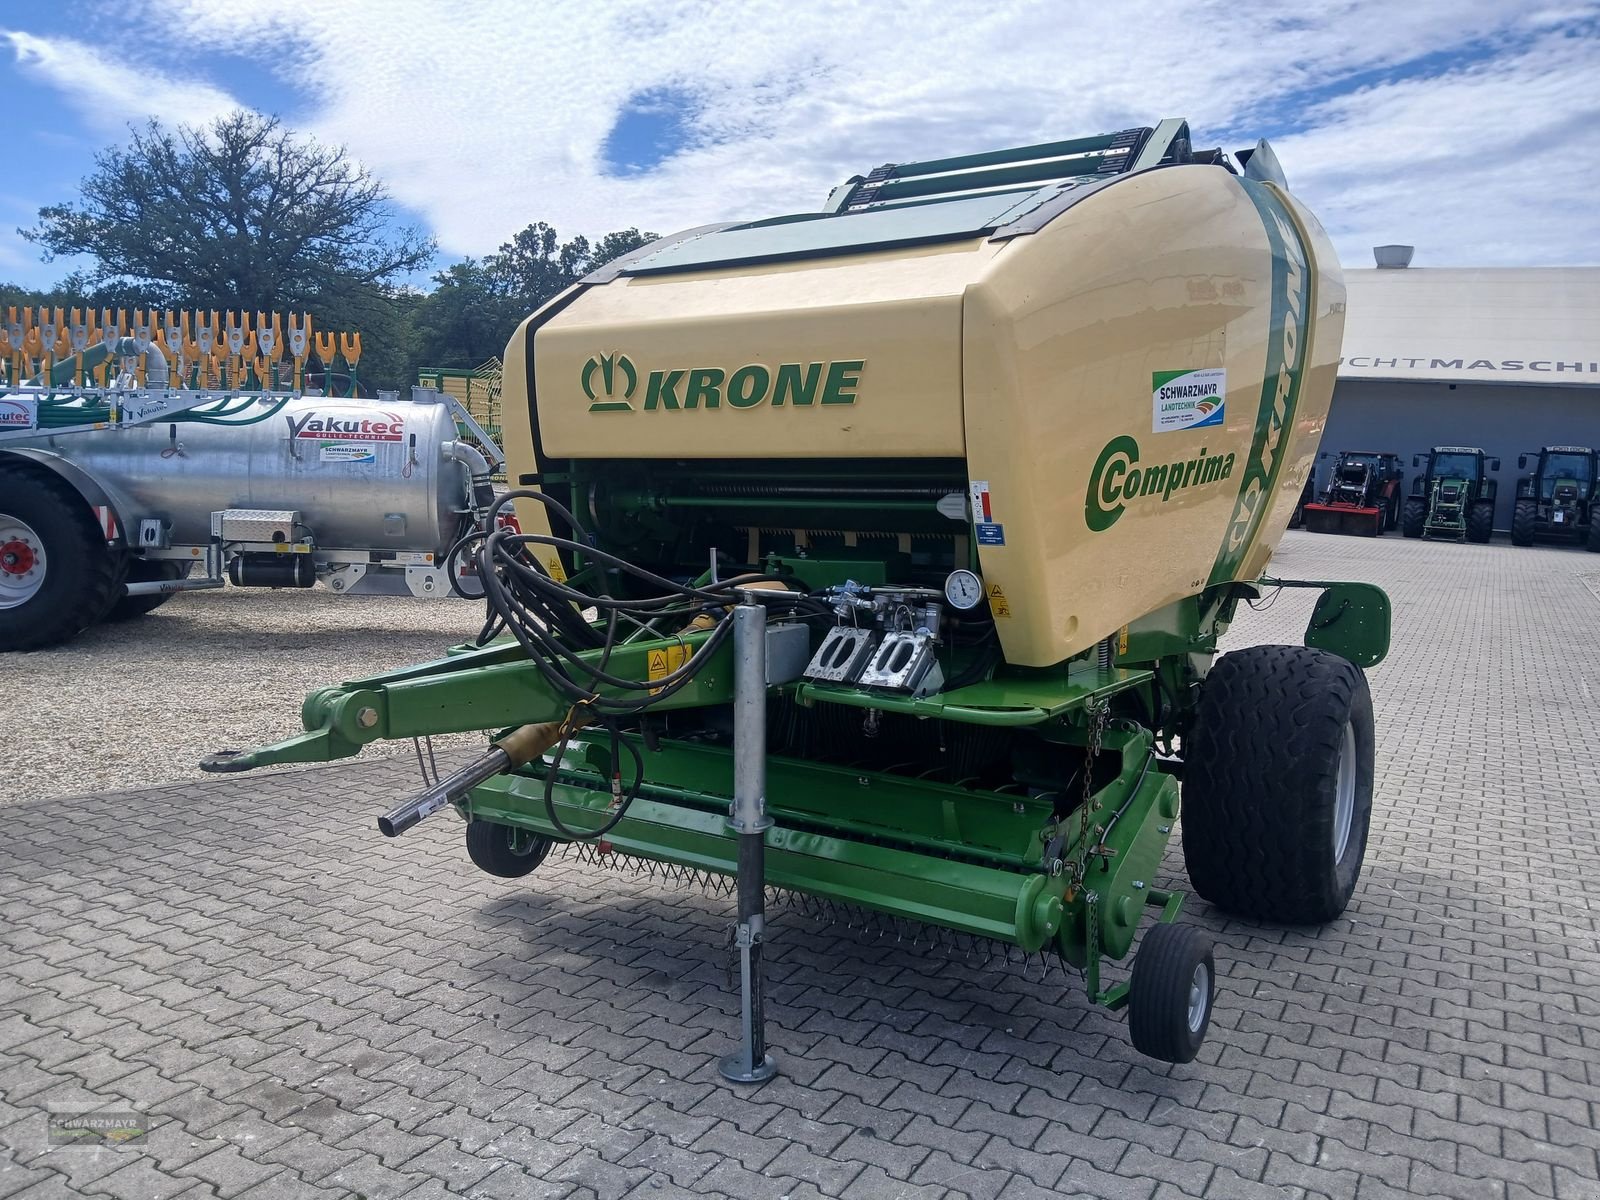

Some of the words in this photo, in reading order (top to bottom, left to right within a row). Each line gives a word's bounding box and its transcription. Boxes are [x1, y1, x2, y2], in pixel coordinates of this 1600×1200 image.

[1260, 207, 1306, 476] KRONE
[643, 359, 867, 411] KRONE
[1160, 383, 1217, 400] SCHWARZMAYR
[1161, 401, 1196, 412] LANDTECHNIK
[286, 412, 404, 437] Yakutec
